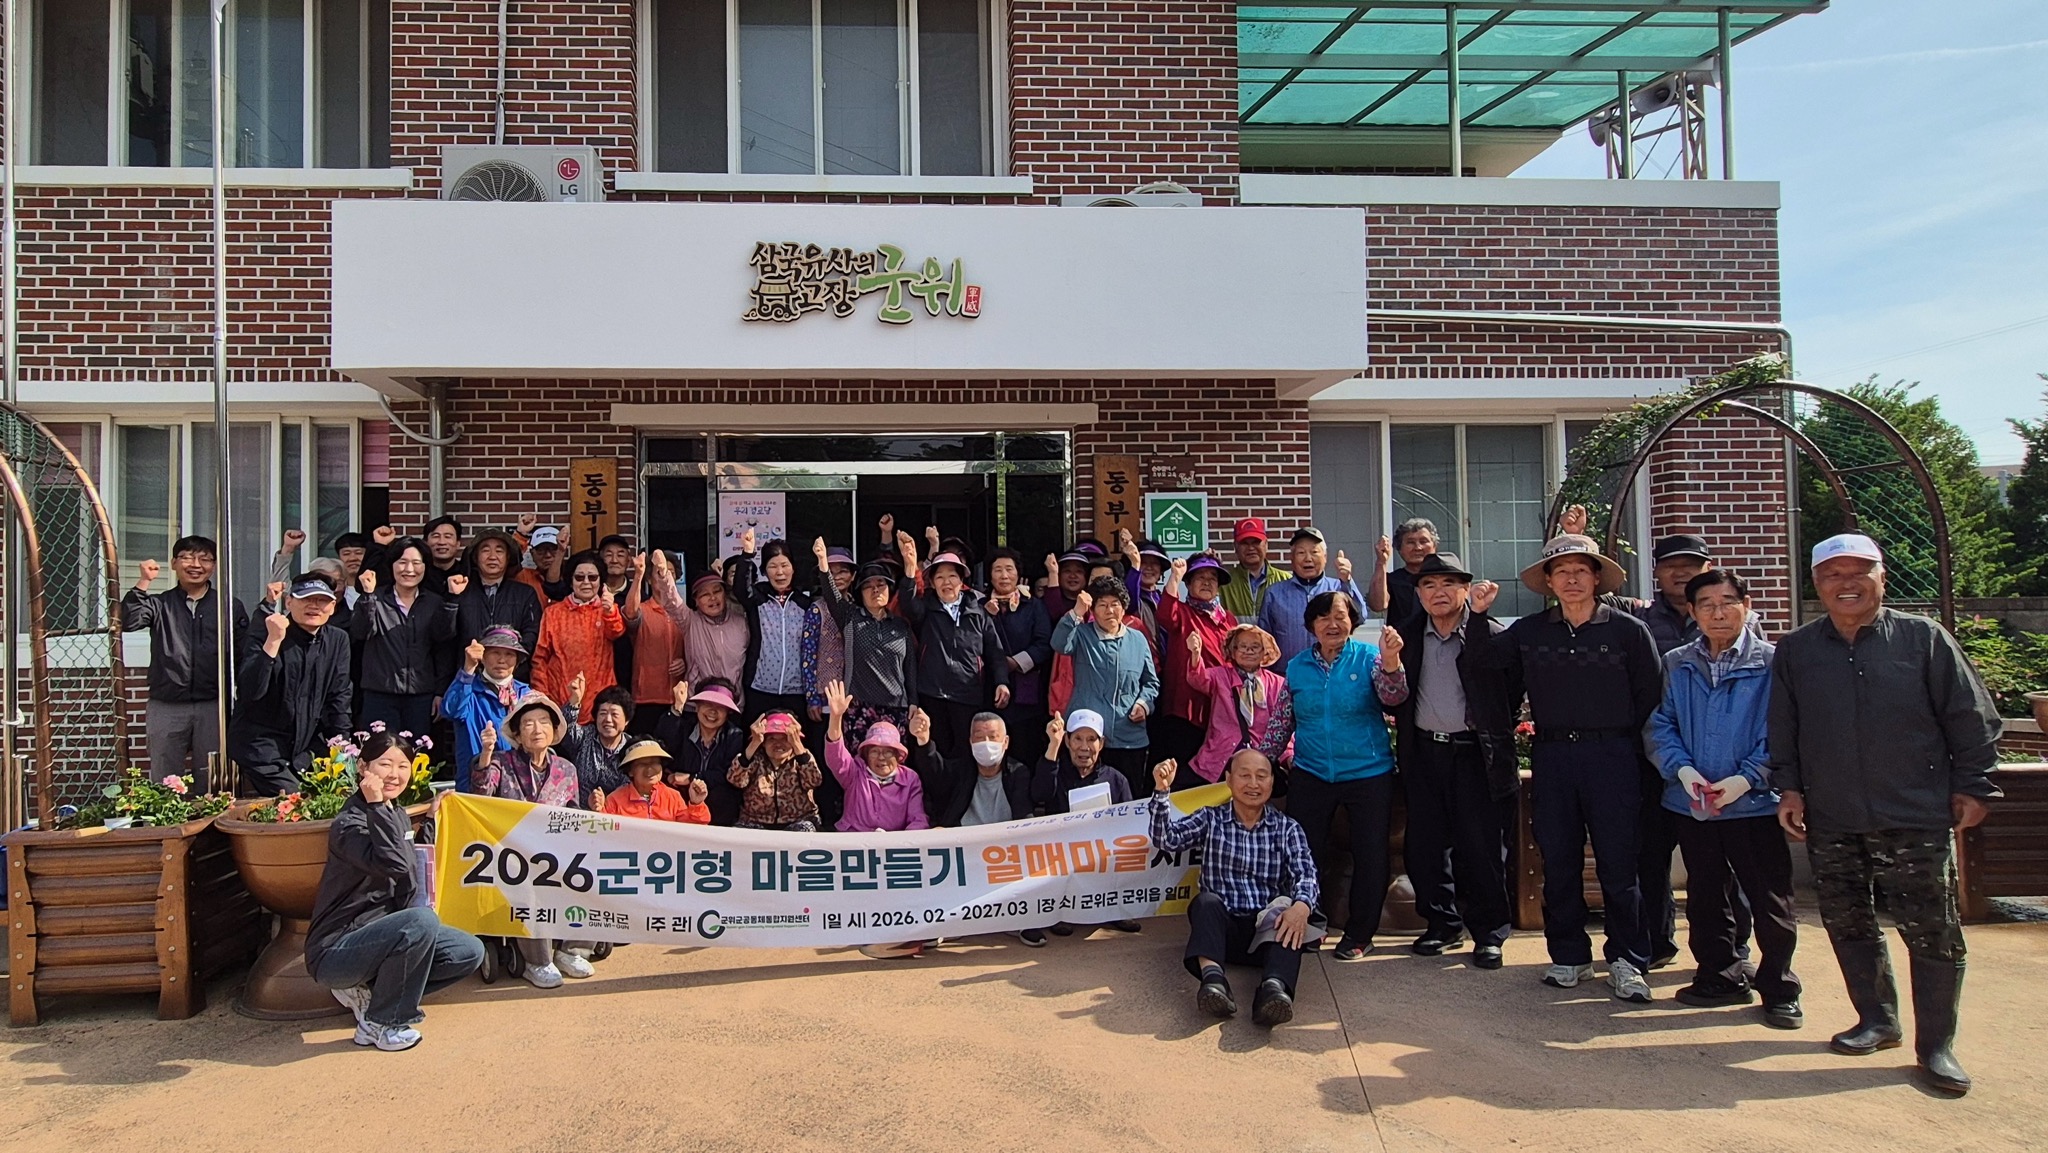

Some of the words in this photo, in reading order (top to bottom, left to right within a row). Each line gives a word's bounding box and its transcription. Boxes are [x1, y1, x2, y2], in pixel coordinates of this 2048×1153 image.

[559, 184, 578, 196] LG
[750, 242, 877, 282] 삼국유사의
[799, 278, 857, 316] 고장
[858, 244, 964, 323] 군위
[1092, 805, 1129, 818] 행복한
[1134, 803, 1149, 815] 군
[581, 815, 614, 833] 군위
[752, 846, 966, 892] 마을만들기
[1081, 892, 1118, 909] 군위군
[1123, 887, 1161, 904] 군위읍
[1165, 885, 1191, 900] 일대
[589, 909, 629, 925] 군위군
[871, 910, 918, 927] 2026.
[924, 908, 945, 923] 02
